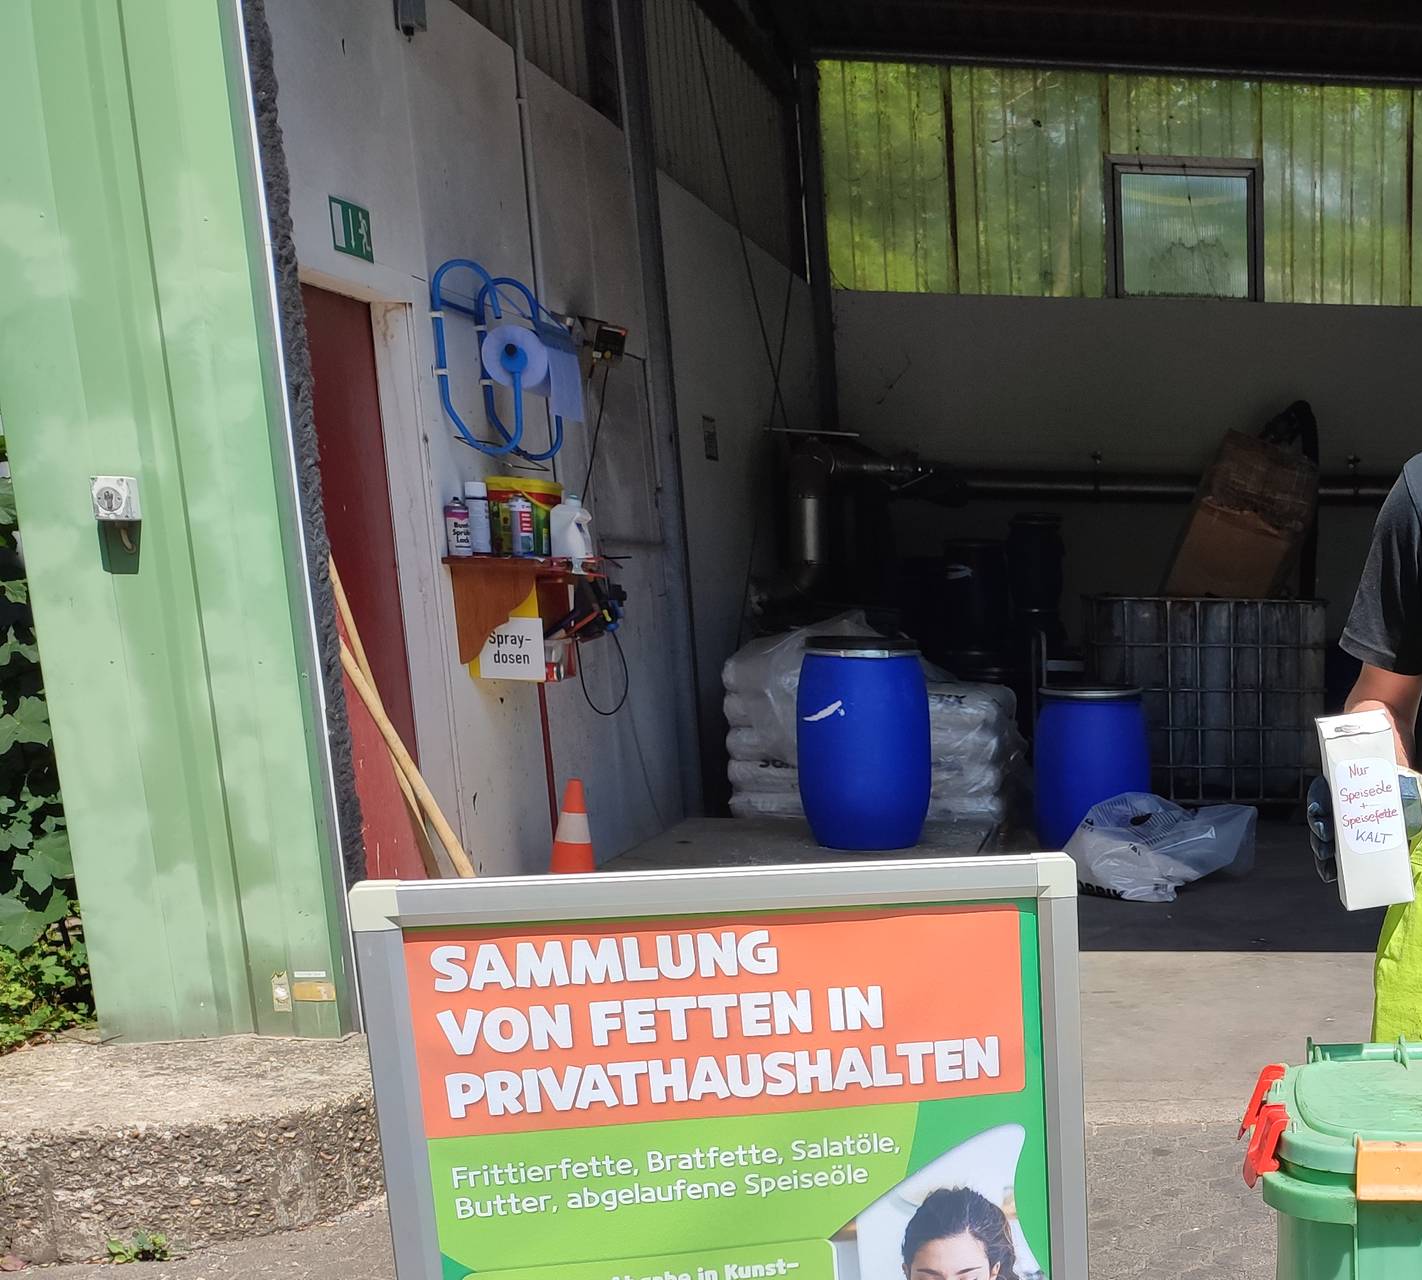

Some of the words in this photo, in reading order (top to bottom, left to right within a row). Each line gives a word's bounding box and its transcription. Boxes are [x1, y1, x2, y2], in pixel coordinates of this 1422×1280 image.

[488, 631, 532, 649] Spray-
[493, 651, 530, 665] dosen
[1348, 763, 1370, 779] Nur
[1339, 779, 1393, 804] Speiseöle
[1342, 808, 1399, 829] Speisefette
[1355, 829, 1393, 844] KALT
[429, 929, 778, 993] SAMMLUNG
[436, 1003, 574, 1056] VON
[588, 988, 813, 1047] FETTEN
[827, 984, 885, 1032] IN
[444, 1035, 1001, 1119] PRIVATHAUSHALTEN
[451, 1154, 639, 1190] Frittierfette,
[646, 1139, 785, 1173] Bratfette,
[790, 1131, 901, 1162] Salatöle,
[455, 1190, 559, 1220] Butter,
[566, 1177, 737, 1211] abgelaufene
[744, 1164, 869, 1196] Speiseöle
[697, 1267, 718, 1280] in
[724, 1258, 800, 1280] Kunst-
